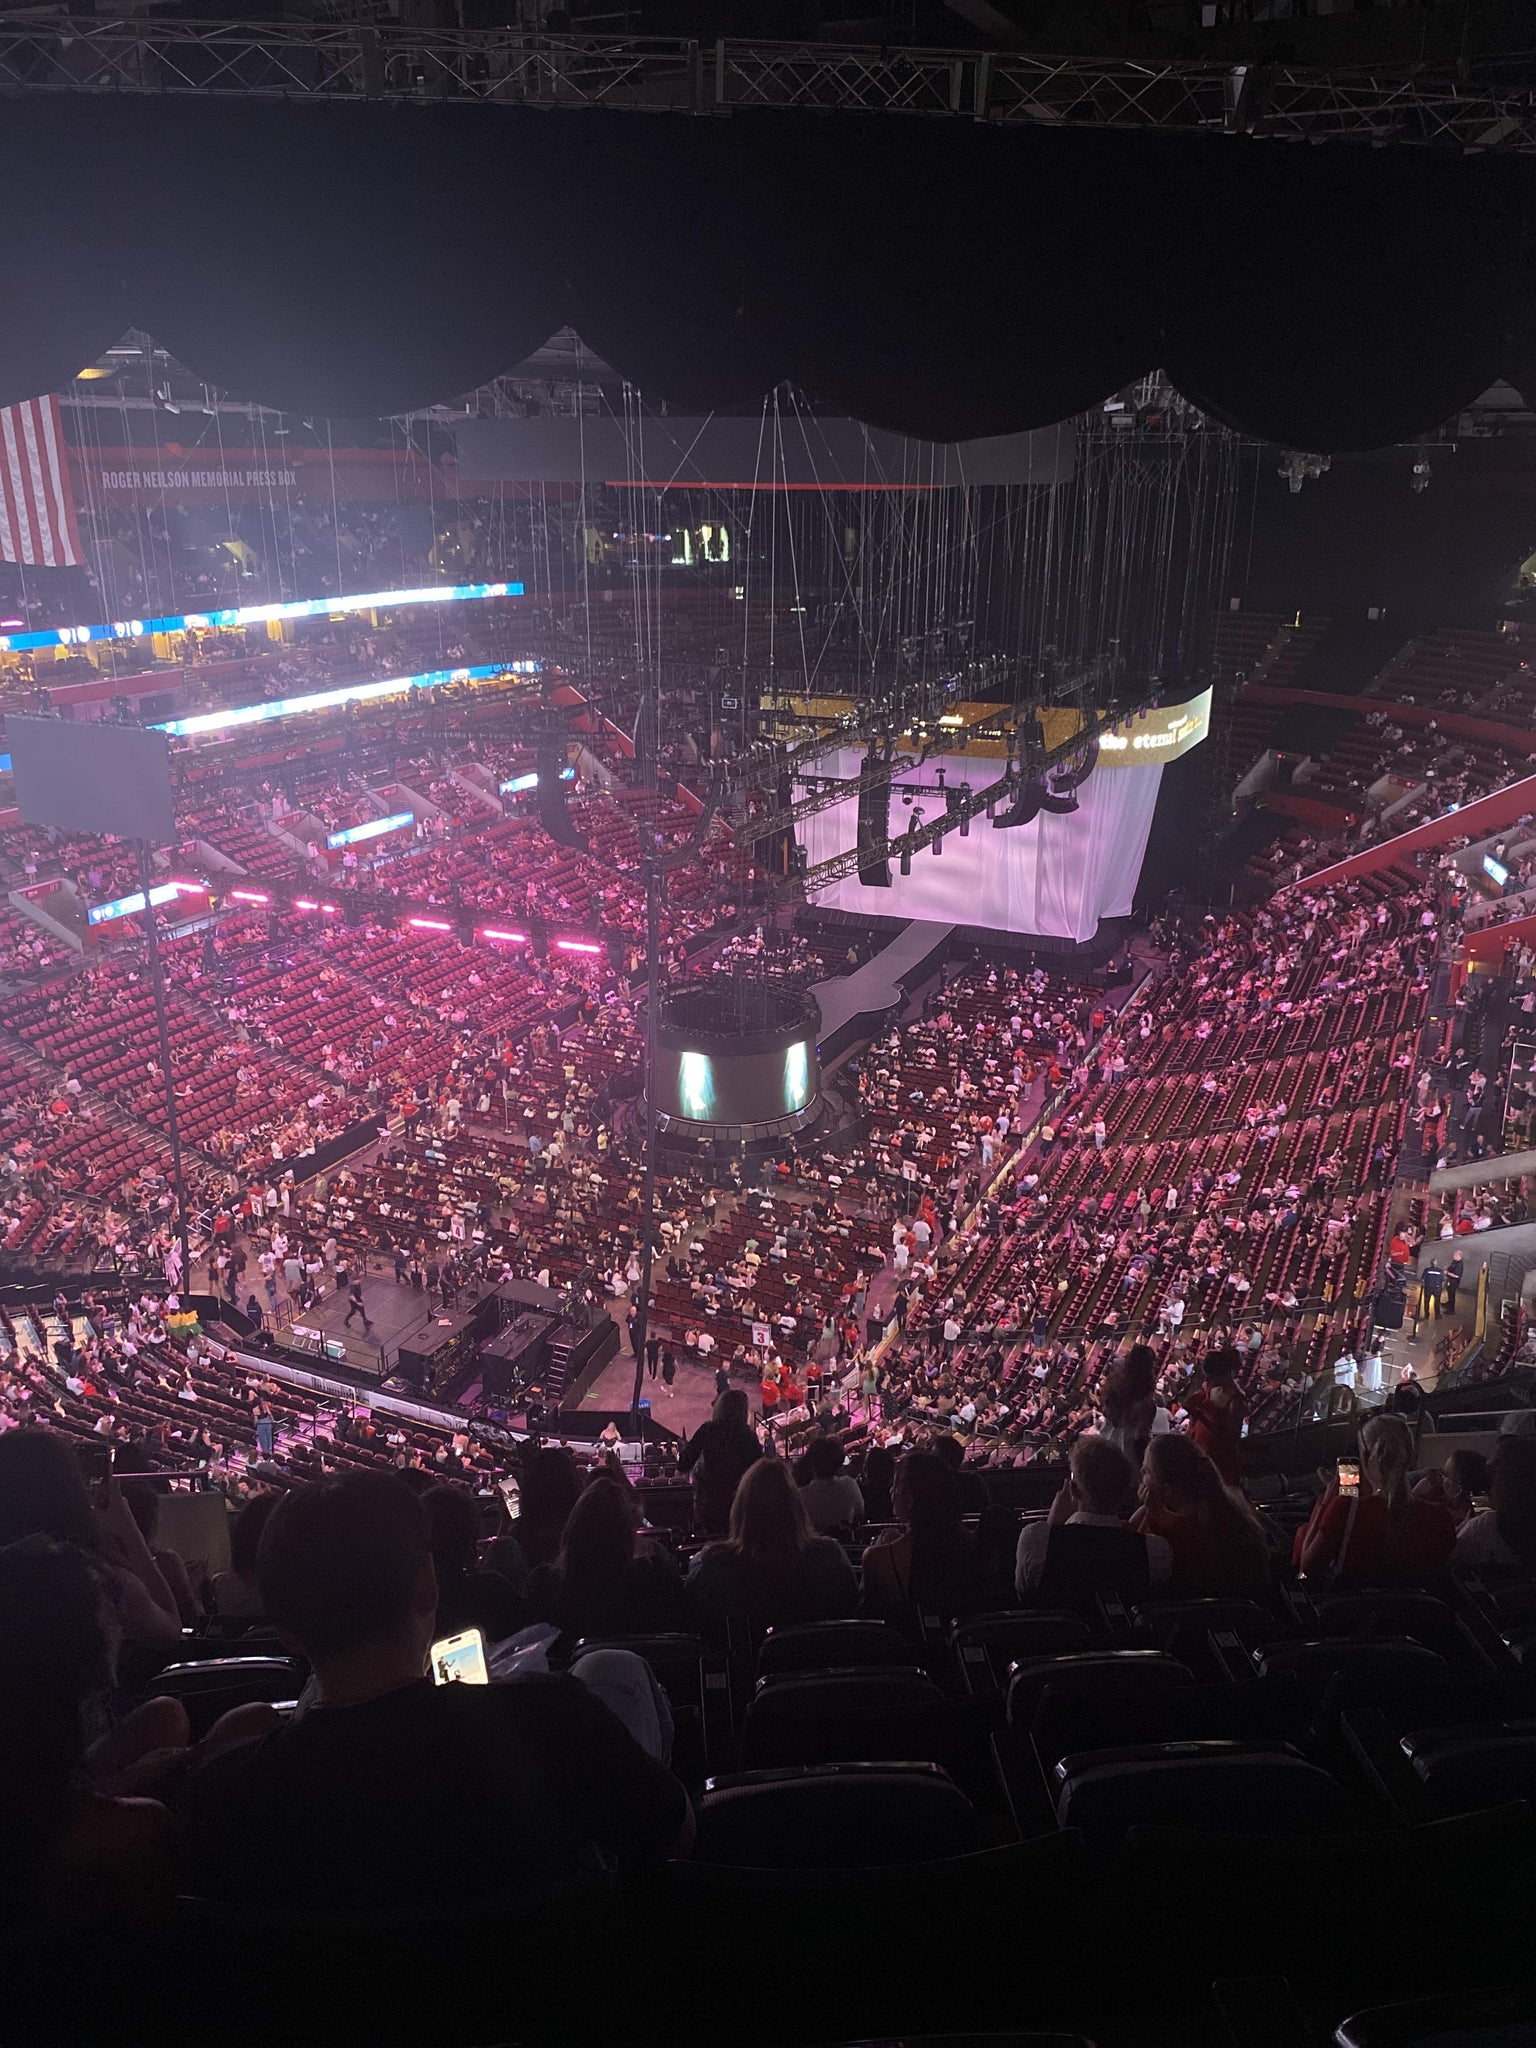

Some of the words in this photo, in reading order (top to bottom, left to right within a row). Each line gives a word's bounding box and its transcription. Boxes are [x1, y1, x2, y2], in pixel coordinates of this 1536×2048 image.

[101, 471, 141, 489] ROGER
[143, 471, 190, 488] NEILSON
[191, 470, 245, 488] MEMORIAL
[246, 470, 277, 487] PRESS
[278, 470, 297, 487] BOX
[1099, 733, 1128, 750] the
[1133, 727, 1177, 749] eternal
[757, 1332, 765, 1344] 3
